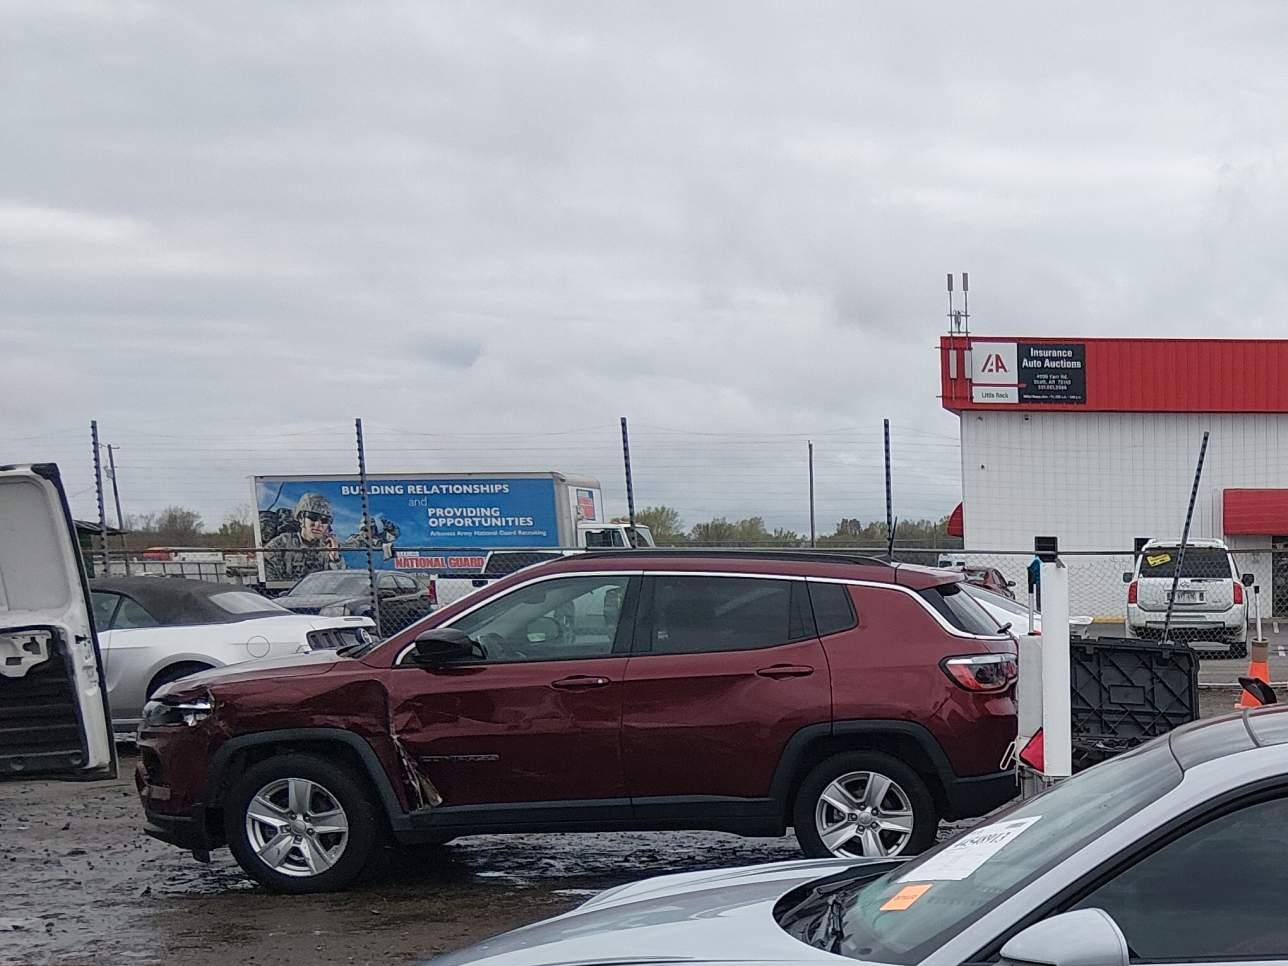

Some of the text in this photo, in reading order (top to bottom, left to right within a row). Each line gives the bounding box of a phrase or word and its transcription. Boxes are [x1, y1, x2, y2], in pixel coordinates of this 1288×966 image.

[1030, 347, 1073, 358] Insurance
[1022, 358, 1082, 369] Auto Auctions
[341, 484, 510, 496] BUDING RELATIONSHIPS
[408, 496, 428, 507] and
[427, 507, 500, 517] PROVIDING
[428, 517, 534, 527] OPPORTUNITIES
[395, 556, 485, 569] NATIONAL GUARD
